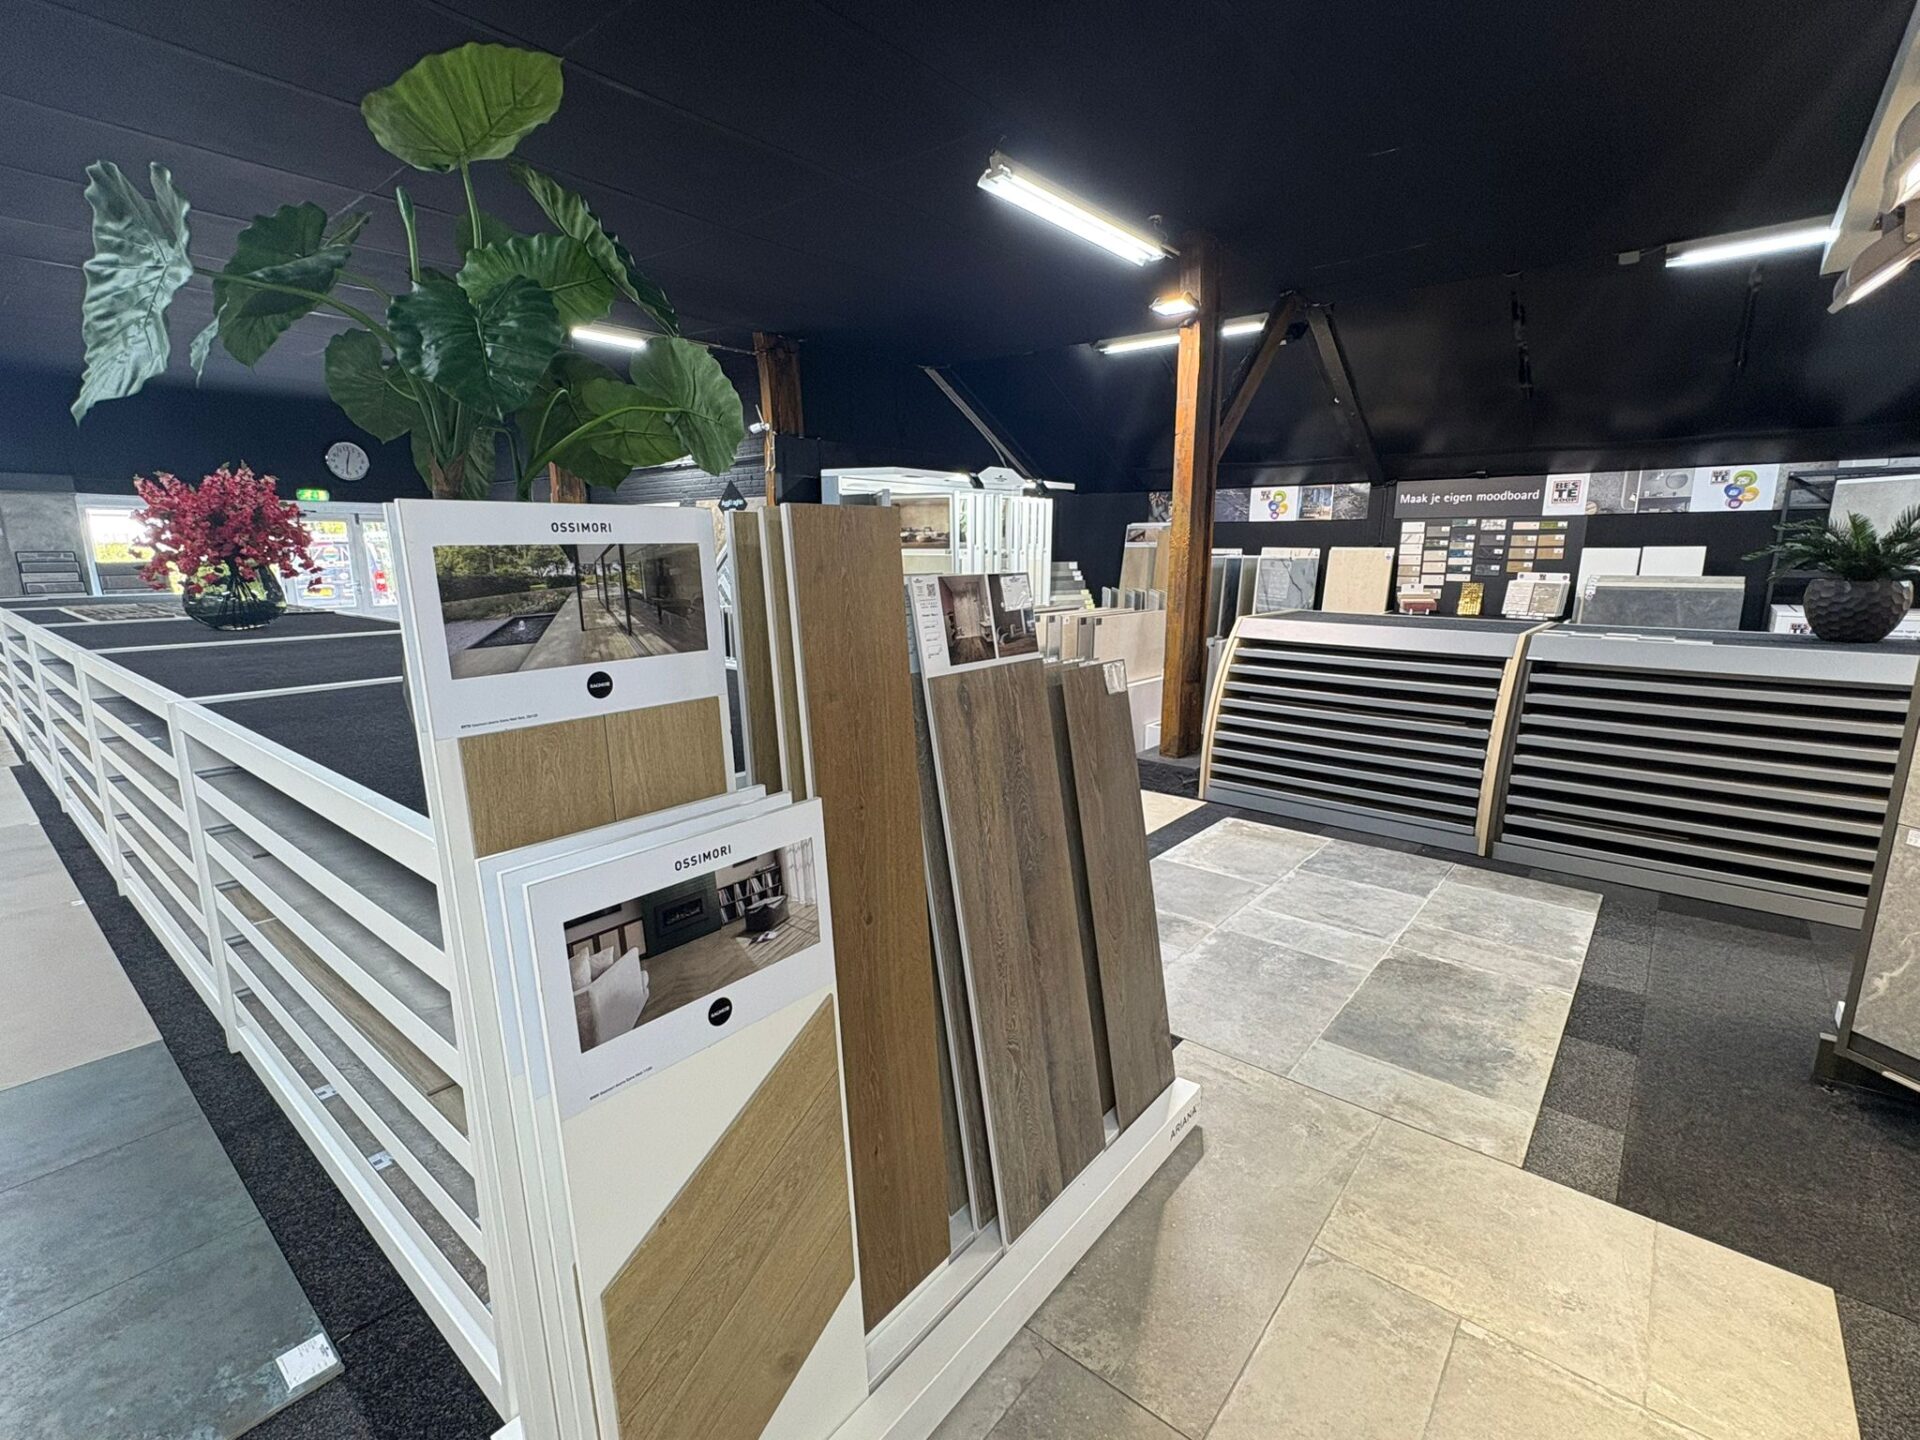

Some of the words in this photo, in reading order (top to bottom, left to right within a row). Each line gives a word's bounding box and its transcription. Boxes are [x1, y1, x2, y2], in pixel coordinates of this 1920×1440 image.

[1400, 493, 1428, 504] Maak
[1429, 492, 1441, 506] je
[1443, 492, 1473, 505] eigen
[1476, 489, 1540, 501] moodboard
[1554, 488, 1578, 498] TE
[551, 521, 613, 533] OSSIMORI
[674, 844, 732, 871] OSSIMORI
